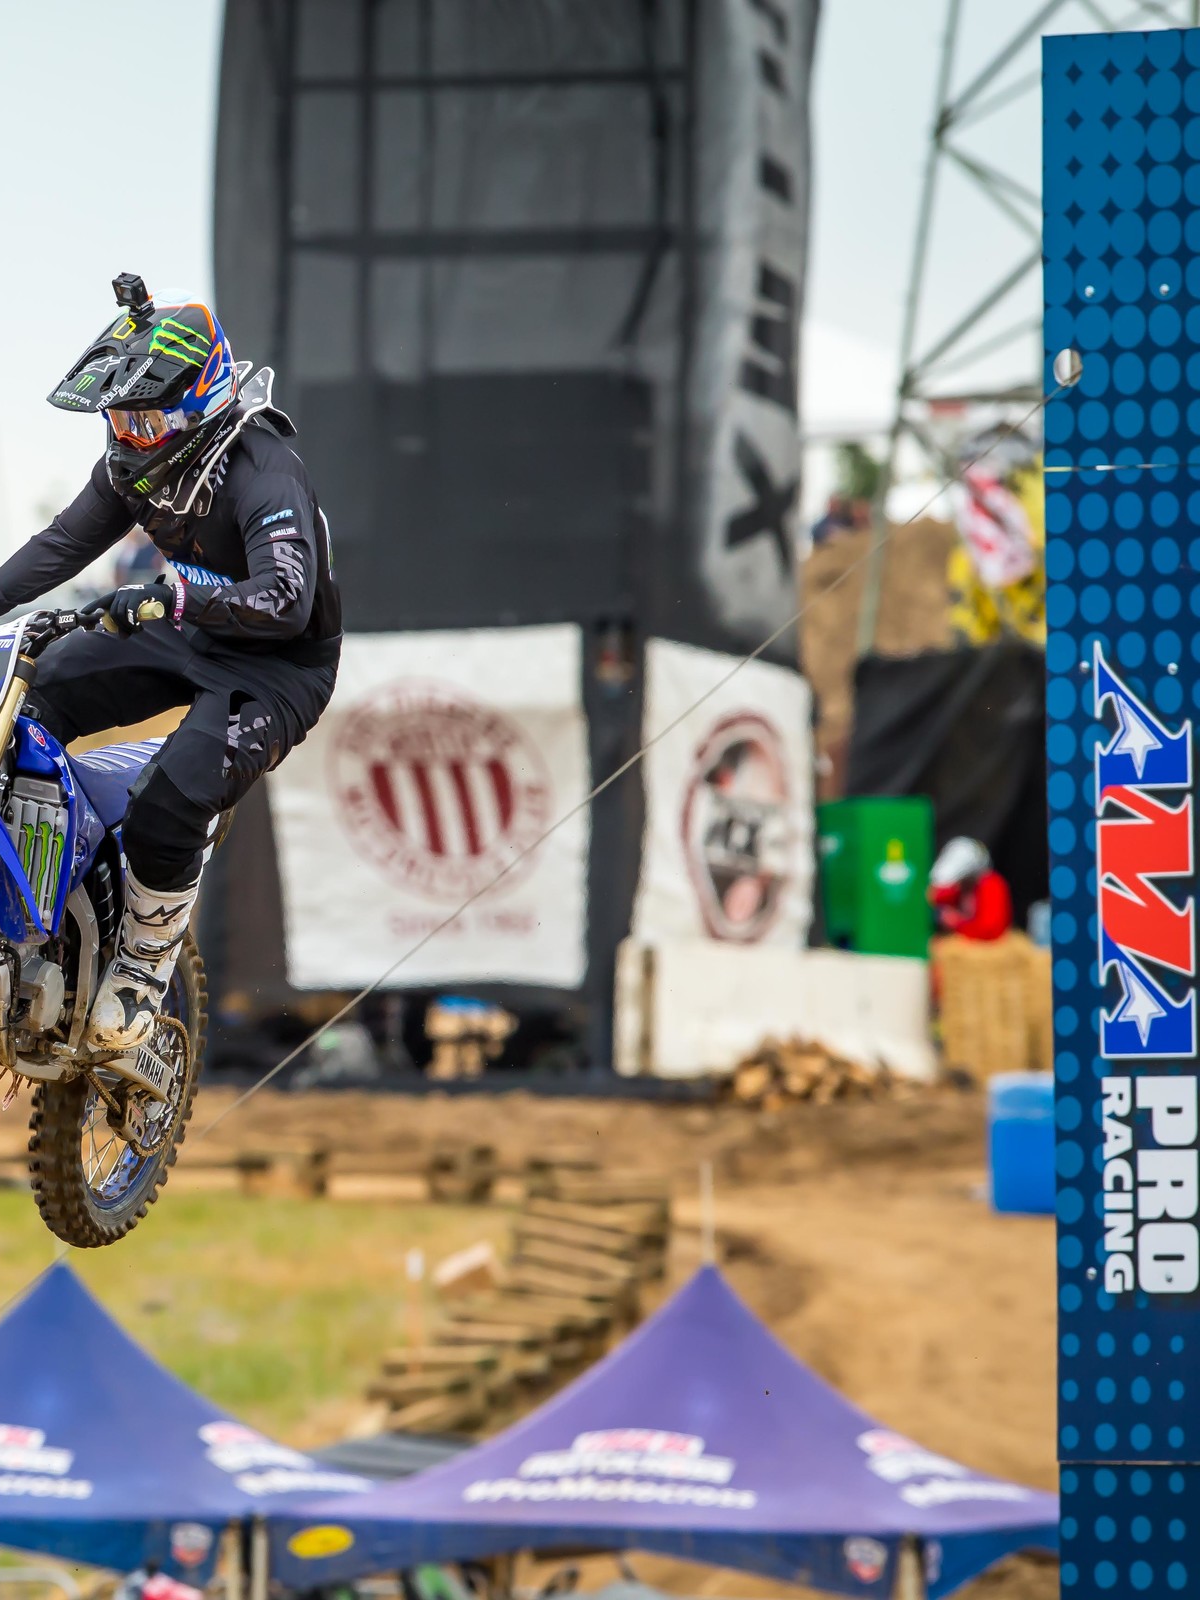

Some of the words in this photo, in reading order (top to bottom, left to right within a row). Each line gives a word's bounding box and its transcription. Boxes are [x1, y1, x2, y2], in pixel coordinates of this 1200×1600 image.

[96, 384, 122, 411] mobius
[262, 509, 293, 526] GYTR
[269, 527, 298, 538] YAMALUBE
[1095, 640, 1197, 1058] AMA
[135, 1047, 165, 1089] YAMAHA
[1101, 1076, 1134, 1294] RACING
[1136, 1075, 1198, 1294] PRO
